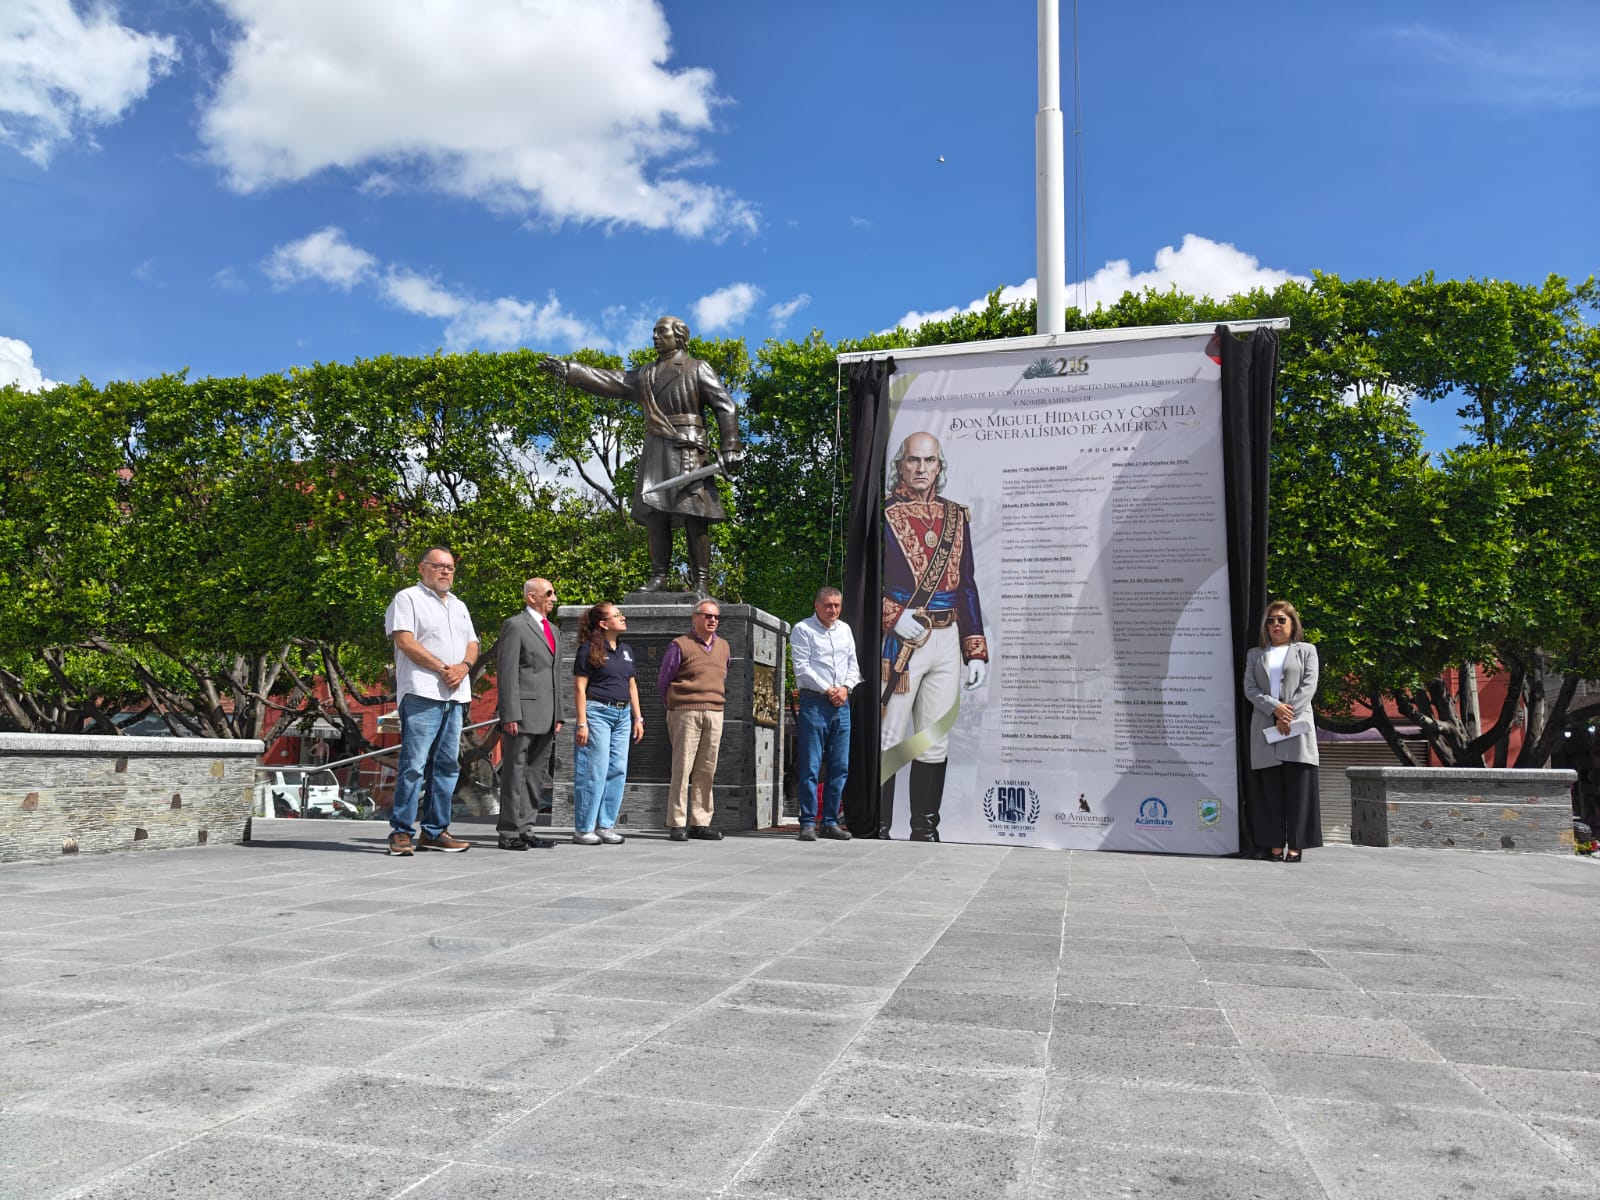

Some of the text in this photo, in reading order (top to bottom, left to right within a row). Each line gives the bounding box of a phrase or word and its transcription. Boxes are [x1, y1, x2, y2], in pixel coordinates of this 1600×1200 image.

[987, 414, 1041, 428] MIGUEL
[1045, 409, 1113, 424] HIDALGO
[1117, 408, 1126, 419] Y
[1130, 404, 1197, 419] COSTILLA
[975, 419, 1168, 441] GENERALÍSIMO DE AMÉRICA
[998, 787, 1025, 823] 500
[1069, 812, 1115, 822] Aniversario
[1135, 817, 1173, 825] Acámbaro
